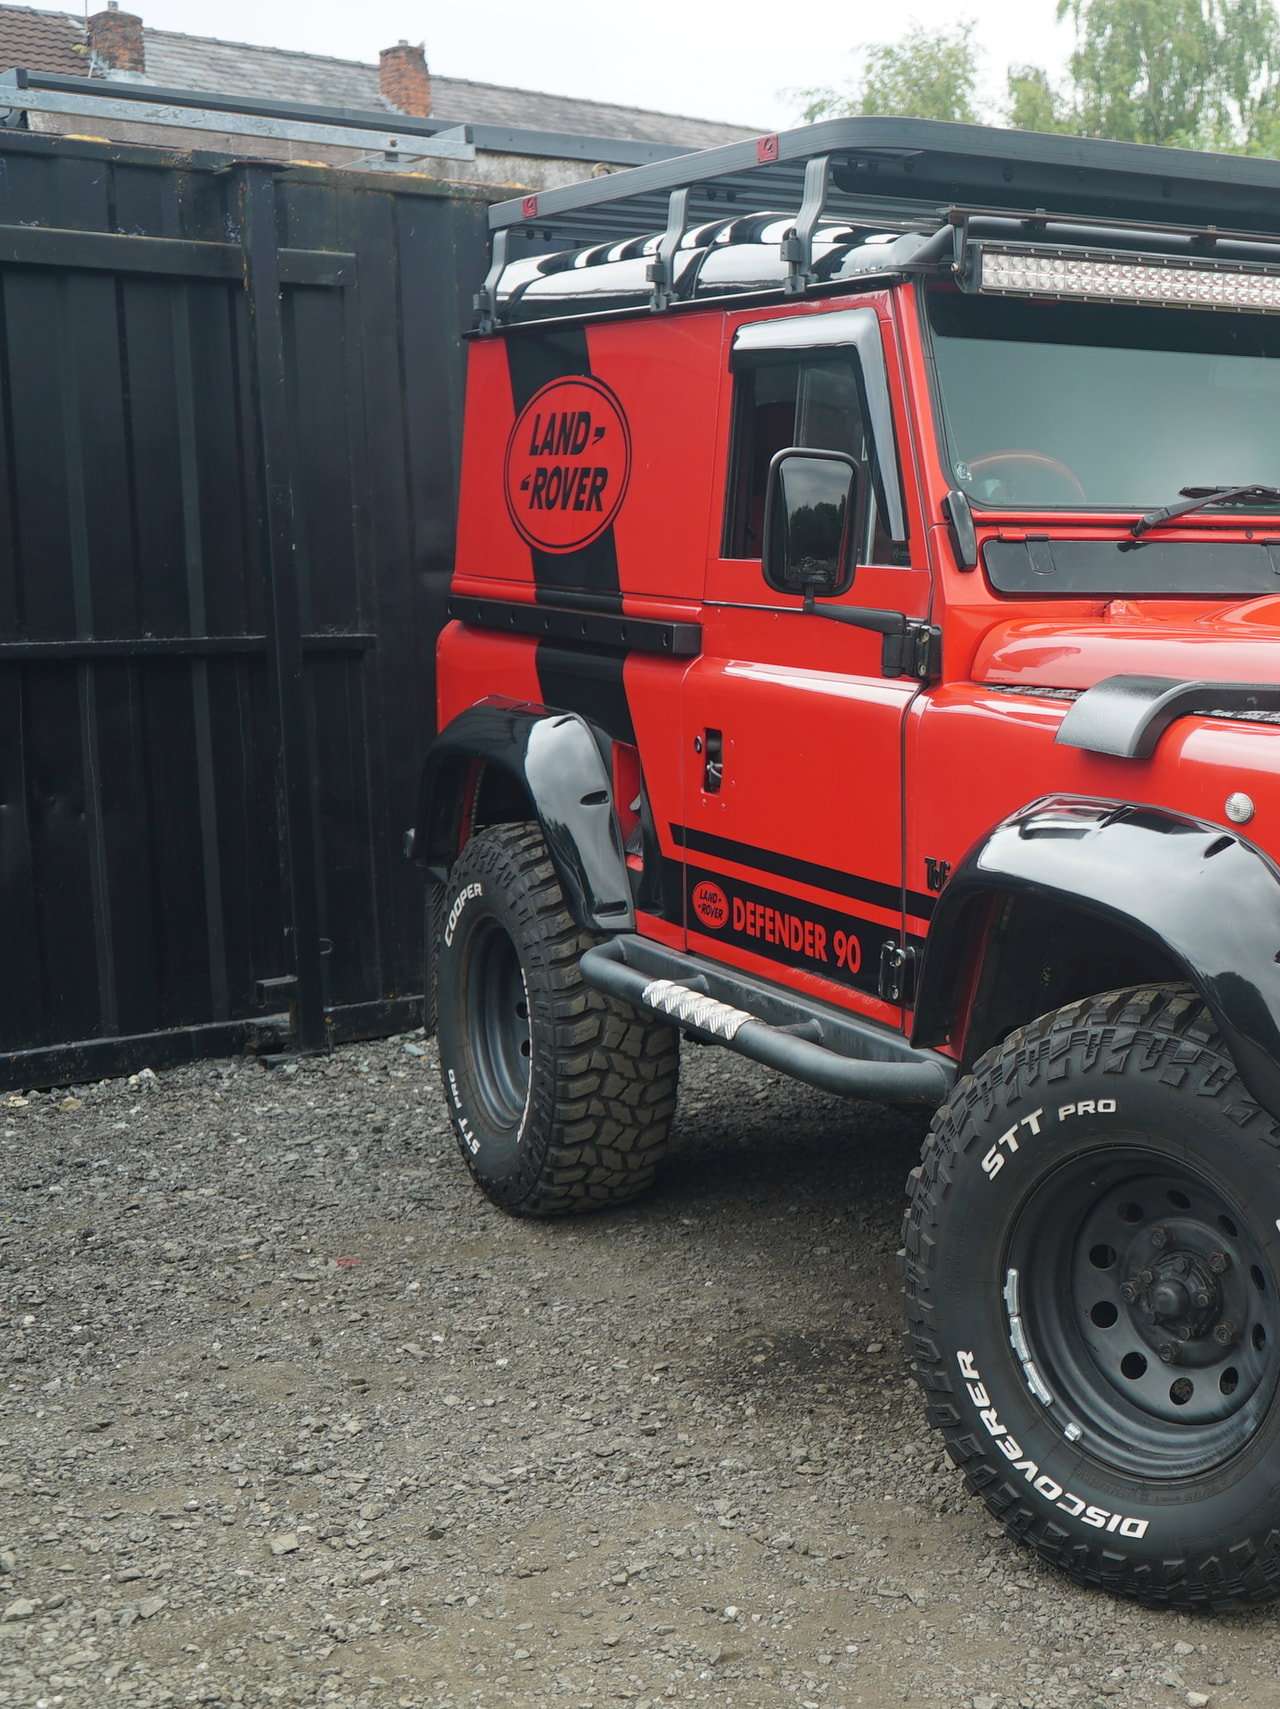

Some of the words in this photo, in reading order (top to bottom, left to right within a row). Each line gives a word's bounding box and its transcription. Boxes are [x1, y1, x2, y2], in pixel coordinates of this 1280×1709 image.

[444, 881, 483, 948] COOPER
[701, 903, 724, 921] ROVER
[732, 896, 828, 963] DEFENDER
[833, 929, 862, 975] 90
[457, 1117, 481, 1156] STT
[980, 1106, 1044, 1182] STT
[1057, 1099, 1118, 1122] PRO
[956, 1350, 1150, 1539] DISCOVERER
